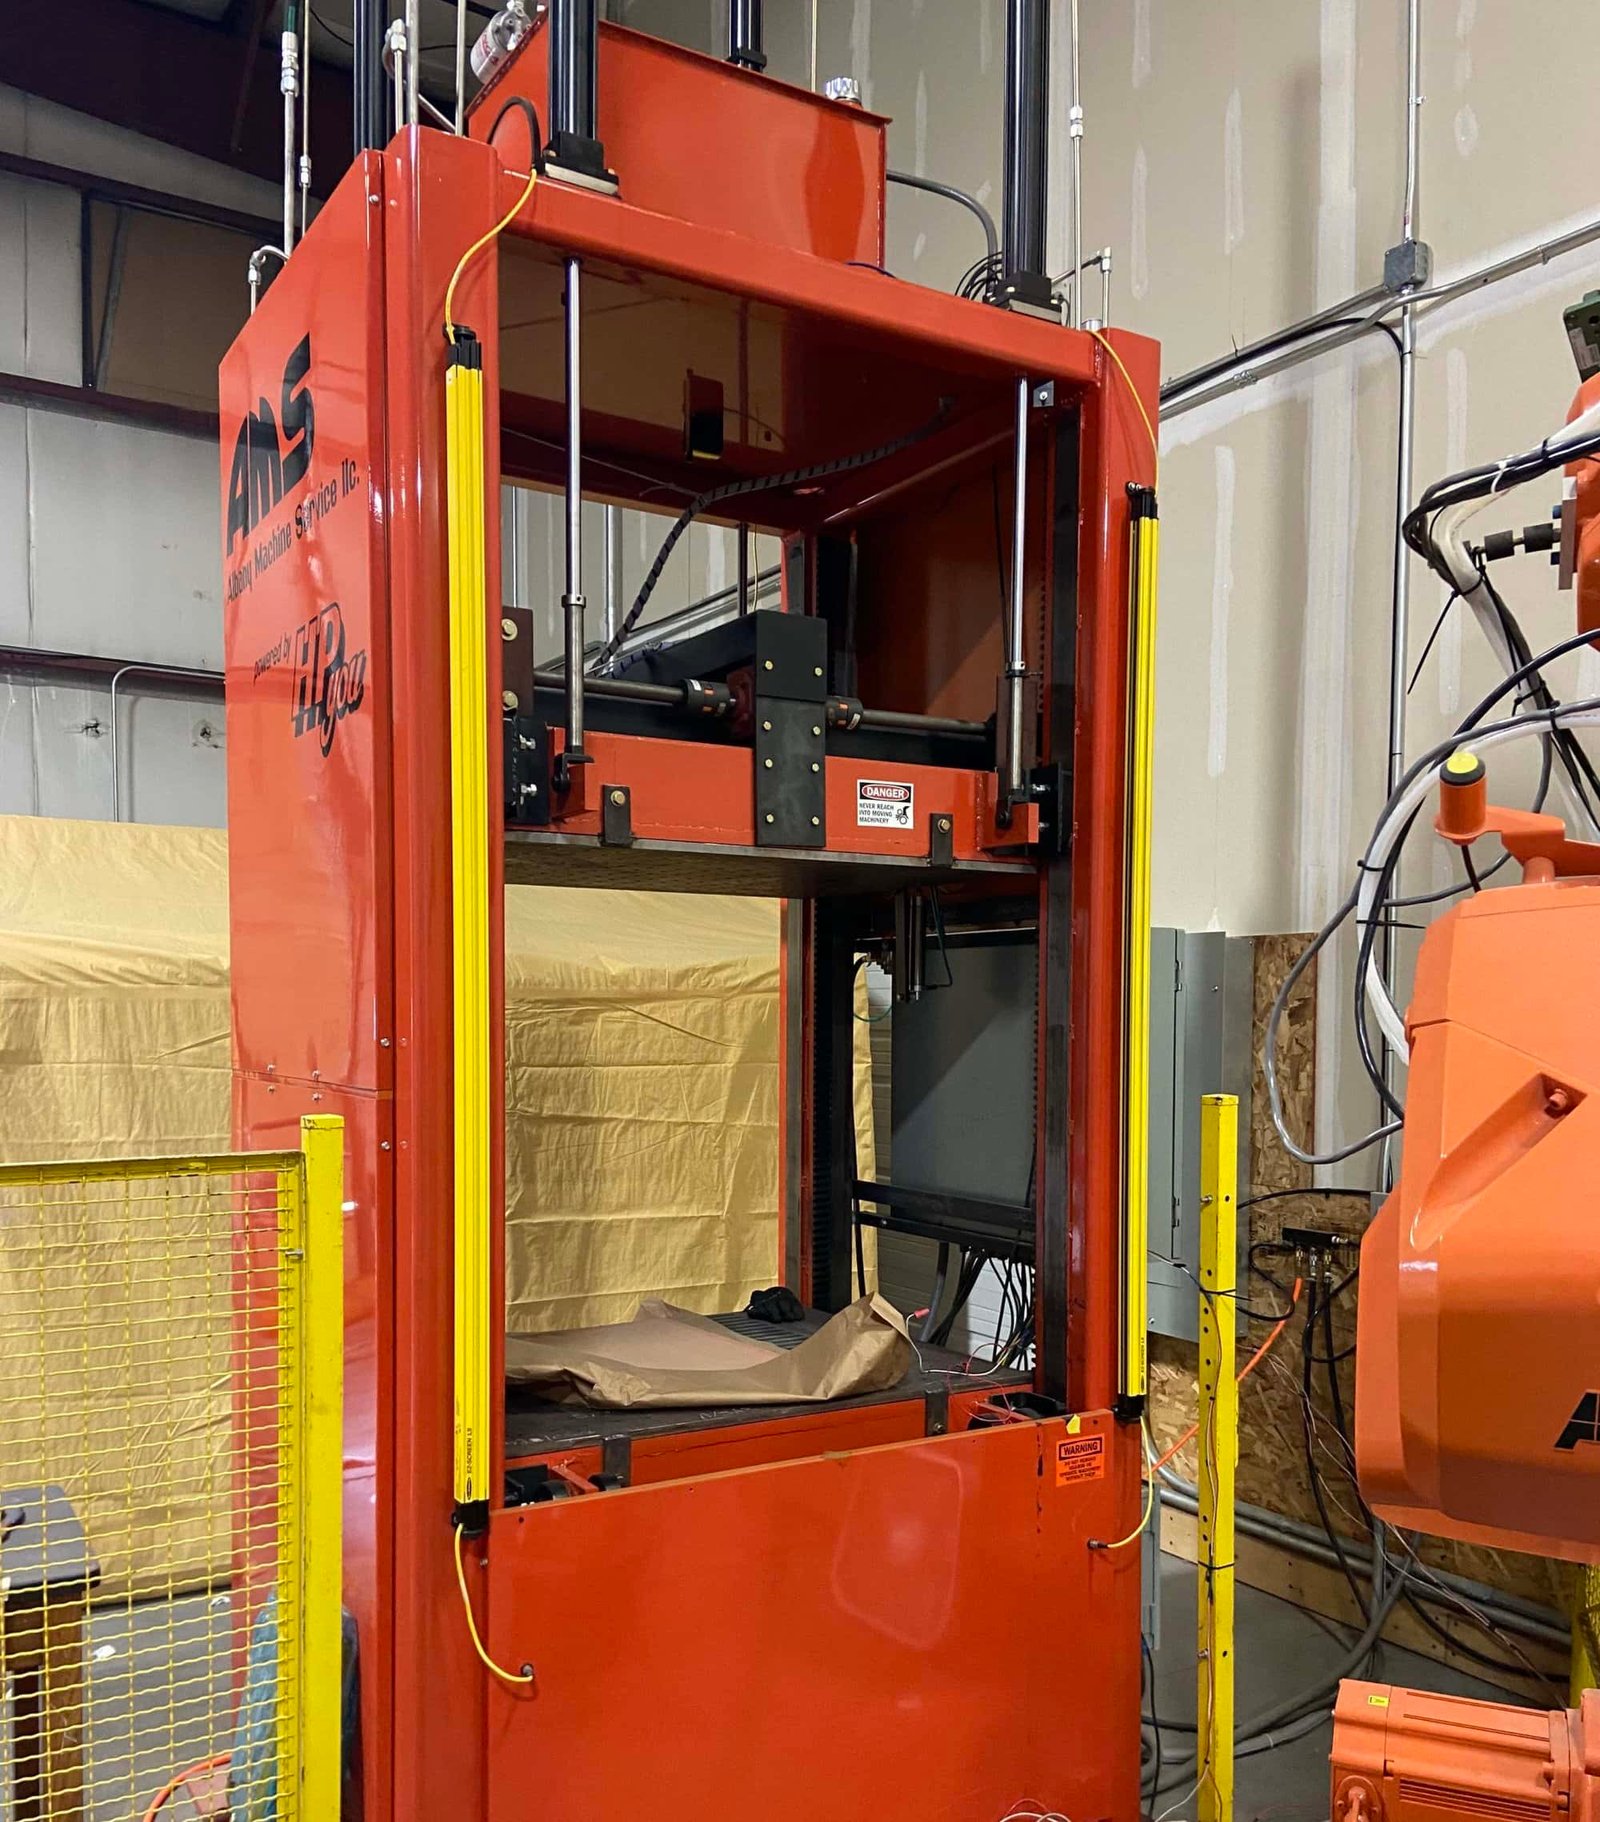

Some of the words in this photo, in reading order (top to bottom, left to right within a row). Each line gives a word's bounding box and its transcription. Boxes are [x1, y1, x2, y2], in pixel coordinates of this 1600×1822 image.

[226, 332, 316, 557] AMS
[228, 558, 252, 603] Albany
[254, 521, 293, 580] Machine
[295, 479, 338, 540] Service
[253, 635, 283, 687] powered
[283, 631, 292, 664] by
[867, 787, 904, 798] DANGER
[1063, 1441, 1098, 1456] WARNING
